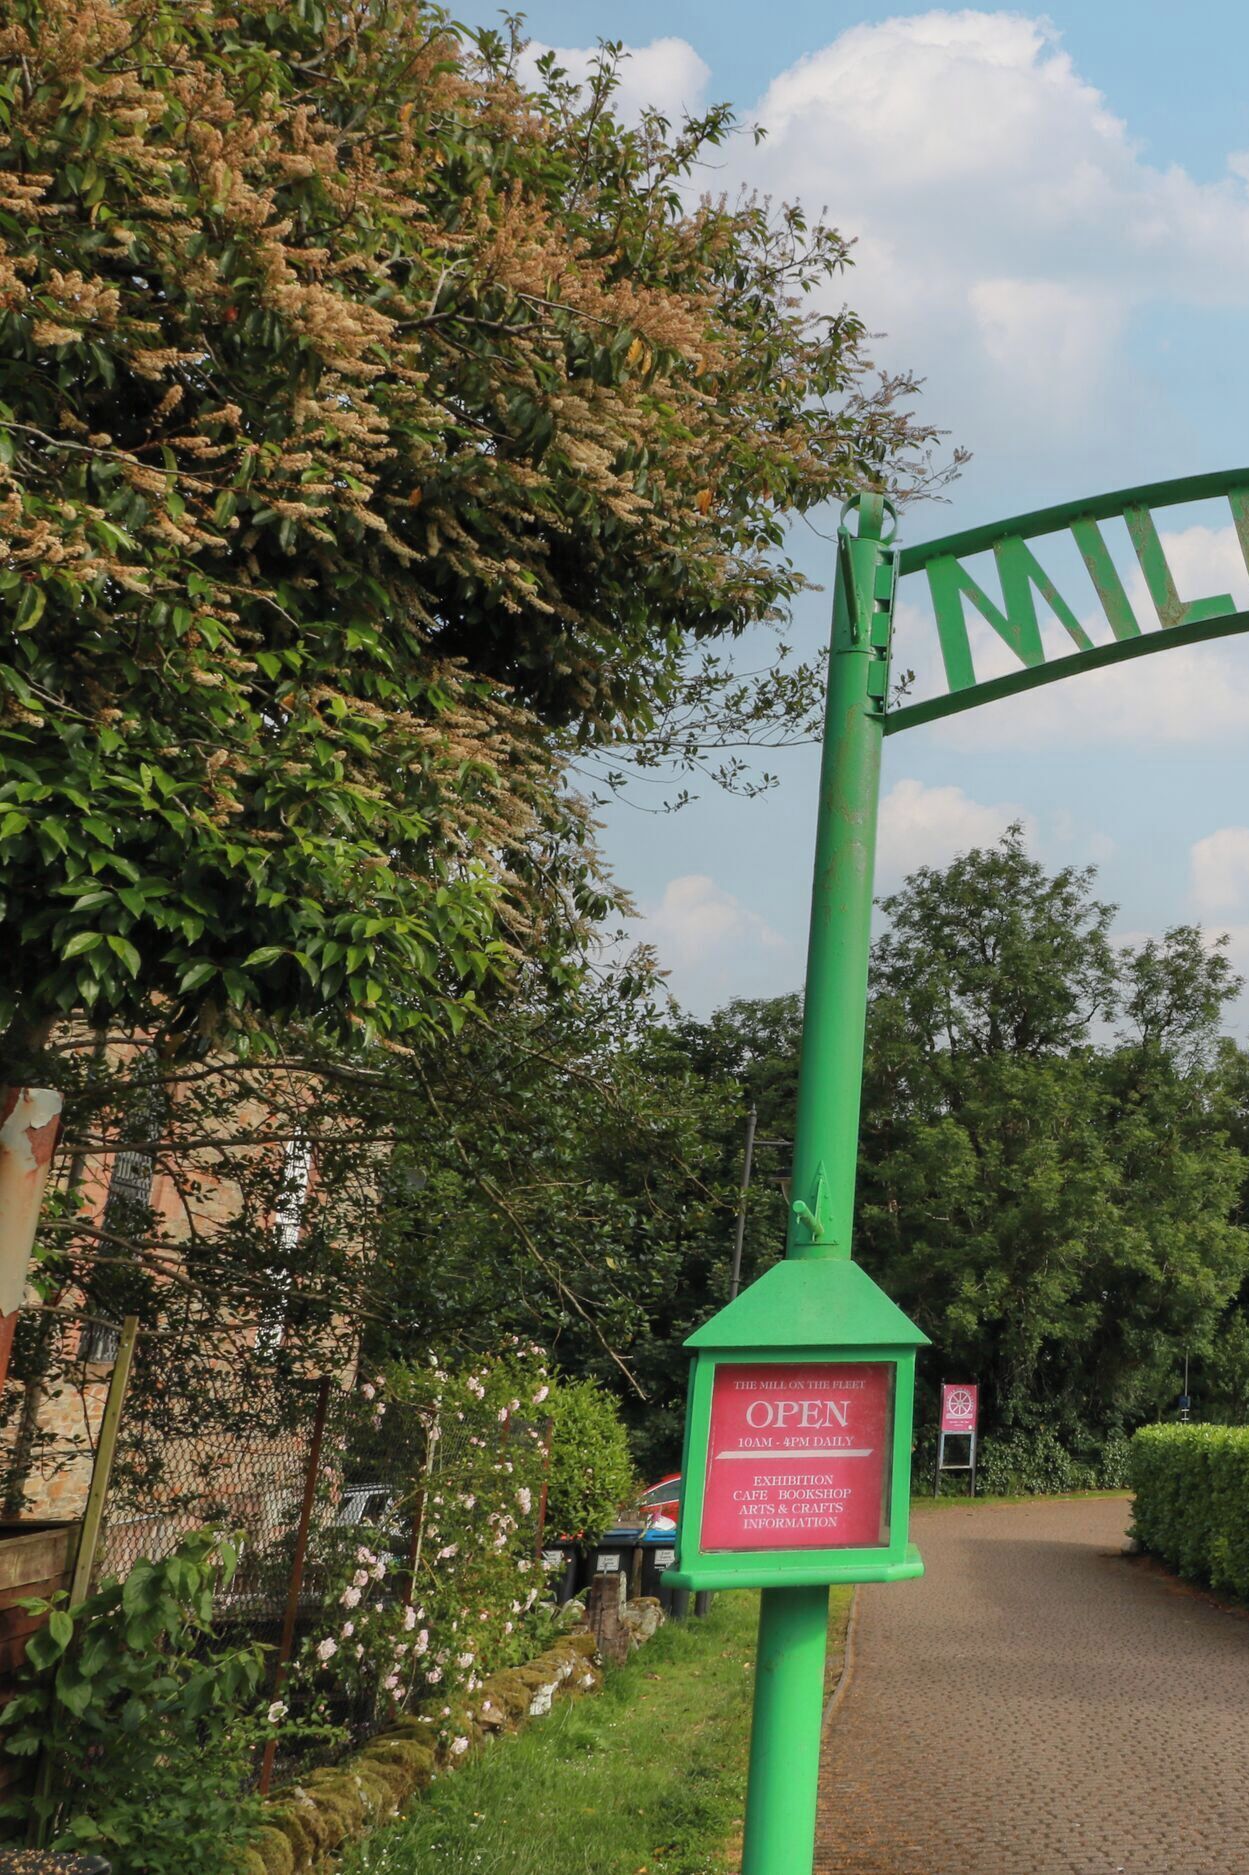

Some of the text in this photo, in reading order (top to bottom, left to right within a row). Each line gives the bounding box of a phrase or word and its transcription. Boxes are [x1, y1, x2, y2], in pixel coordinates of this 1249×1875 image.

[735, 1380, 866, 1390] THE MILL ON THE FLEET
[745, 1399, 851, 1429] OPEN
[738, 1437, 772, 1448] 10AM
[783, 1436, 810, 1447] 4PM
[813, 1435, 854, 1447] DAILY
[753, 1474, 834, 1487] EXHIBITION
[733, 1488, 852, 1501] CAFE BOOKSHOP
[739, 1502, 844, 1515] ARTS & CRAFTS
[743, 1516, 838, 1530] INFORMATION
